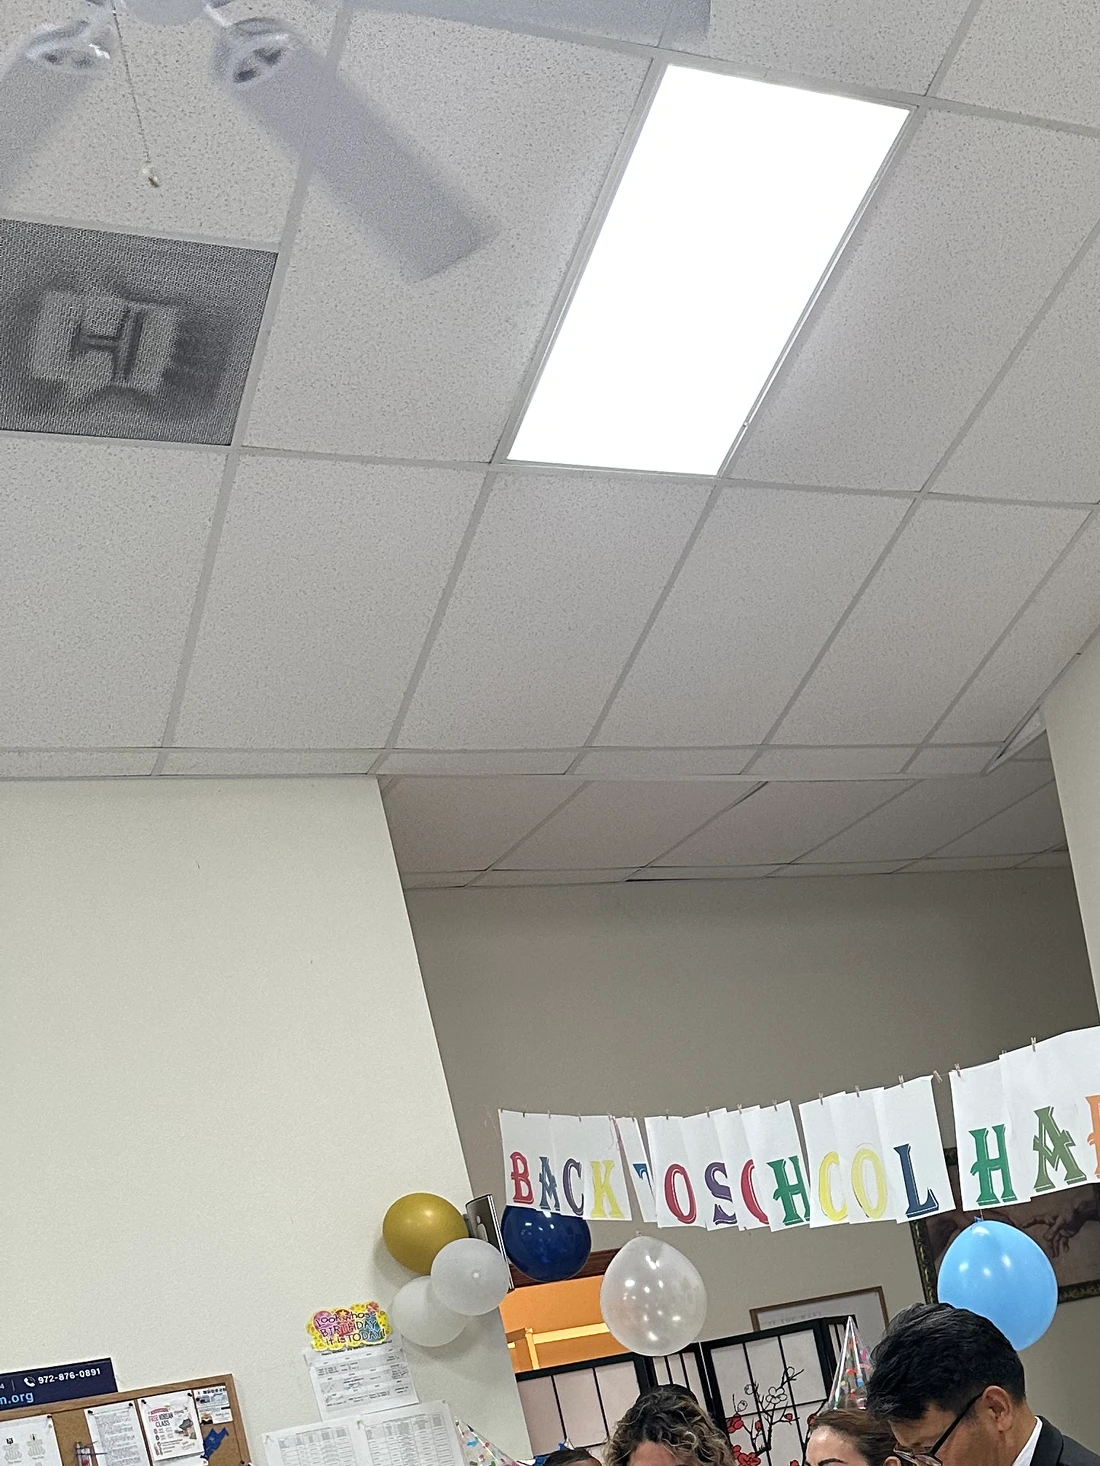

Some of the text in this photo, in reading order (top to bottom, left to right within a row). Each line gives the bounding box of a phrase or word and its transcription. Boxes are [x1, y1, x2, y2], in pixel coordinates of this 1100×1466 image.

[509, 1151, 625, 1219] BACK
[320, 1318, 378, 1338] BIRTHDAY
[347, 1328, 386, 1342] TODAY!
[38, 1368, 101, 1384] 972-876-0891
